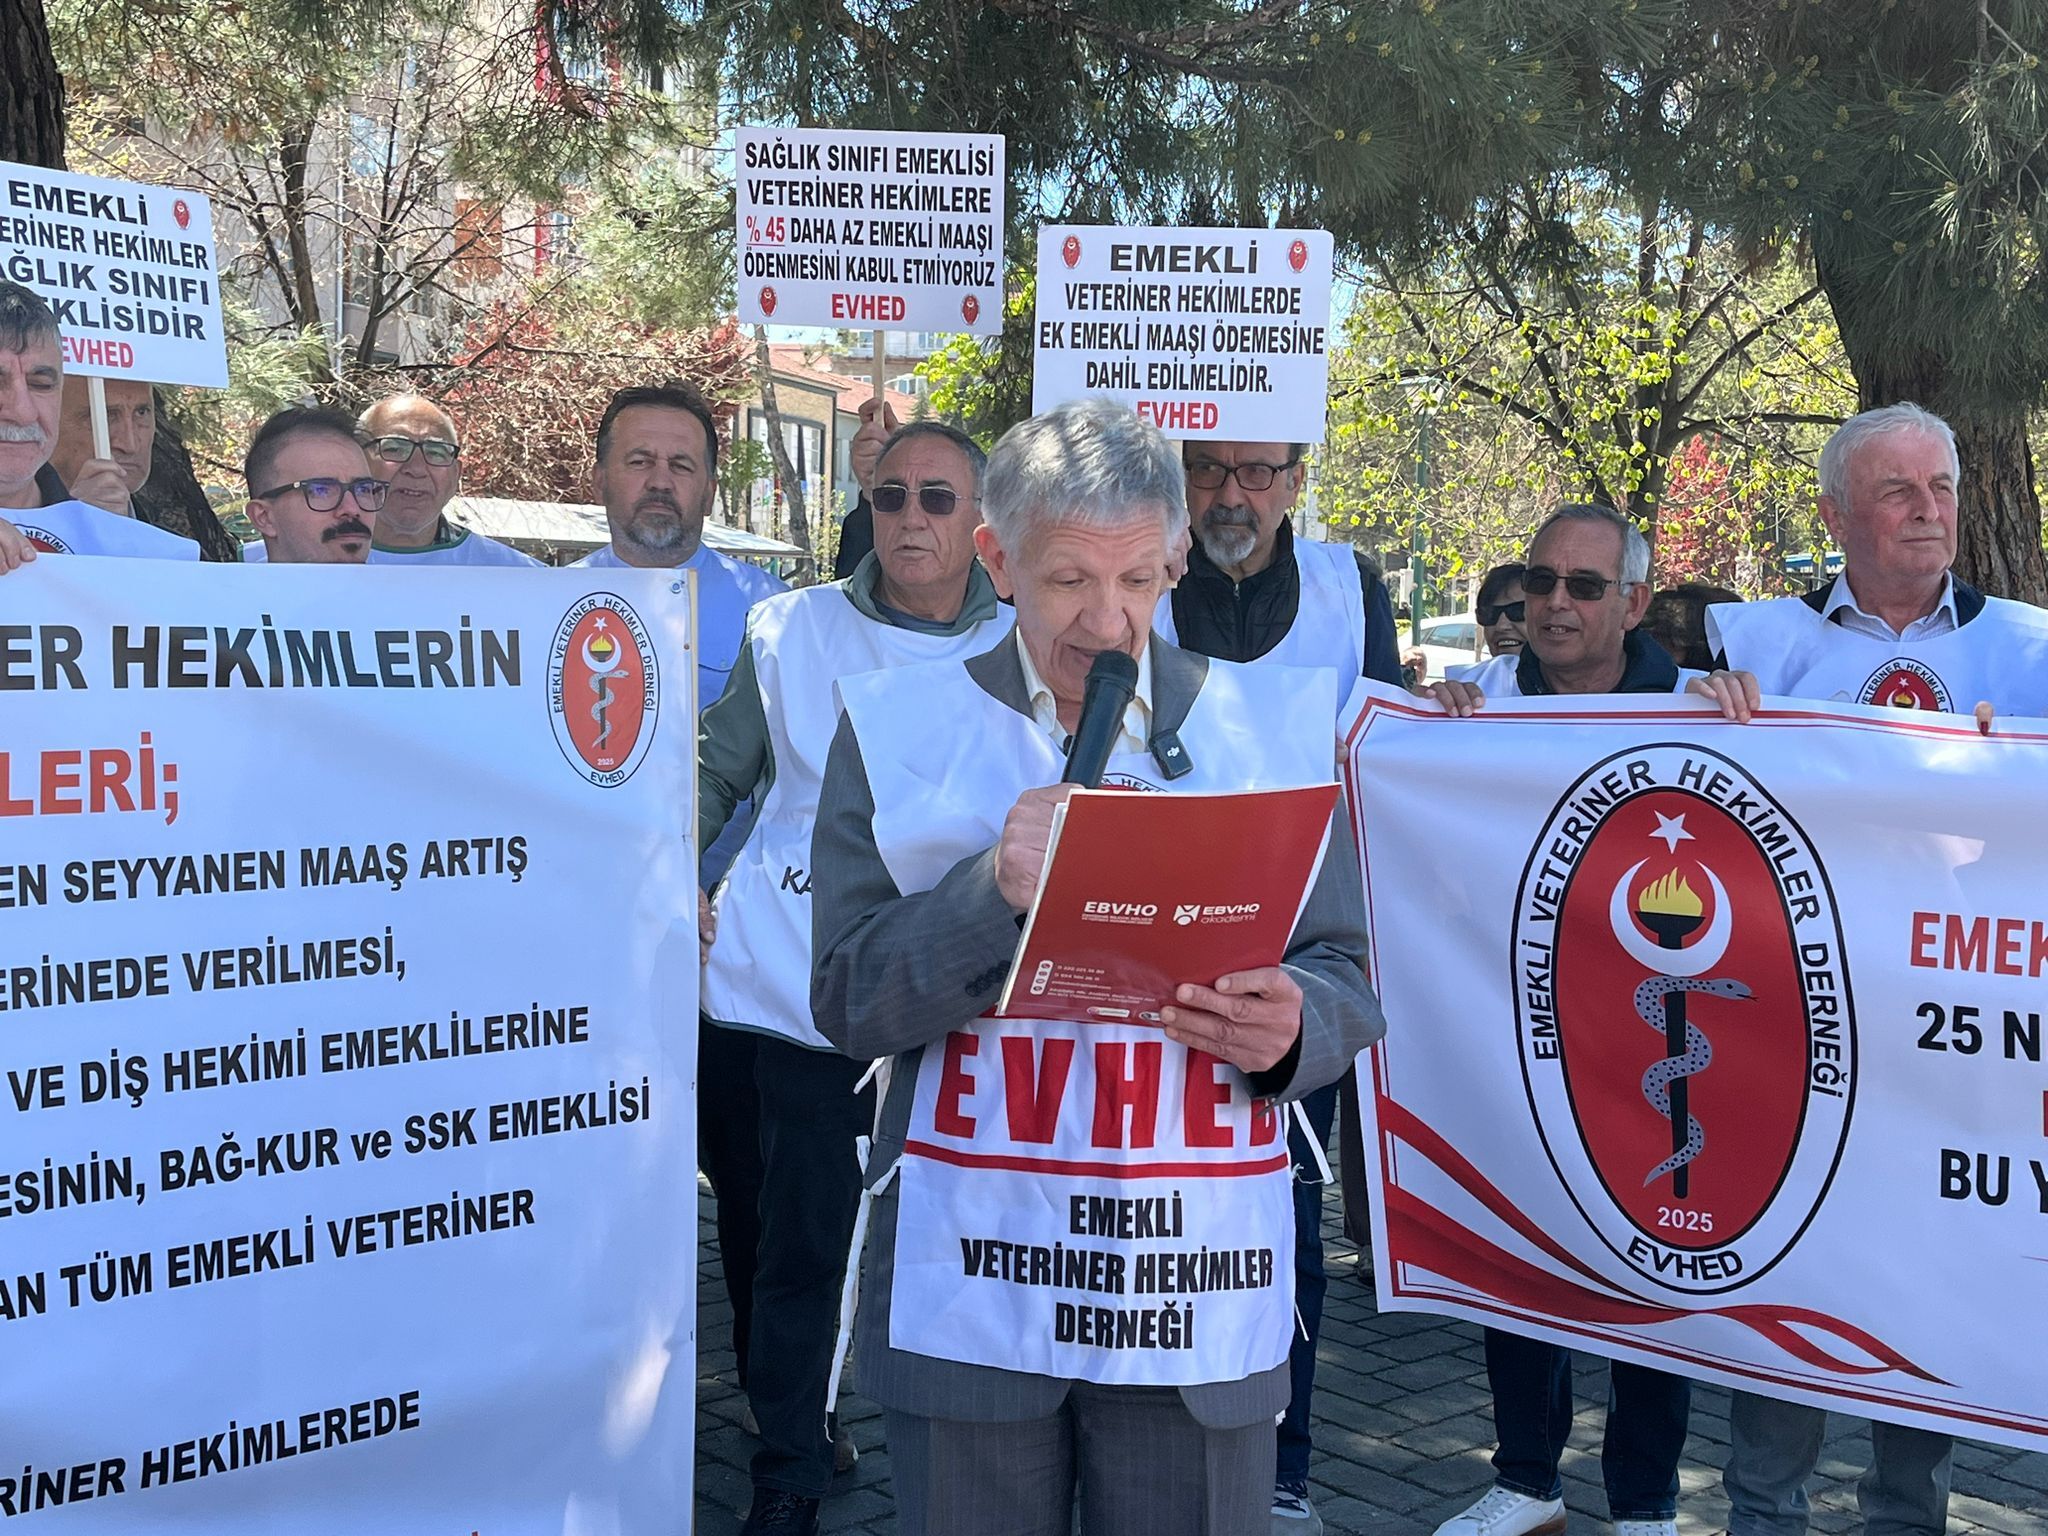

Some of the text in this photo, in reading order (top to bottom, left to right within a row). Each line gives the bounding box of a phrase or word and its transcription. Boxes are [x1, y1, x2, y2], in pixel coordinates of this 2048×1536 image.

[745, 137, 994, 176] SAĞLIK SINIFI EMEKLİSİ
[8, 180, 148, 226] EMEKLİ
[747, 175, 991, 213] VETERİNER HEKİMLERE
[94, 230, 209, 270] HEKİMLER
[746, 215, 993, 257] % 45 DAHA AZ EMEKLİ MAAŞI
[1110, 239, 1258, 274] EMEKLİ
[109, 268, 209, 305] SINIFI
[744, 247, 995, 287] ÖDENMESİNİ KABUL ETMİYORUZ
[42, 297, 206, 340] KLİSİDİR
[832, 294, 905, 321] EVHED
[1065, 277, 1301, 315] VETERİNER HEKİMLERDE
[1040, 316, 1324, 359] EK EMEKLİ MAAŞI ÖDEMESİNE
[1086, 355, 1272, 393] DAHİL EDİLMELİDİR.
[555, 598, 597, 659] VETERİNER
[604, 597, 648, 650] HEKİMLER
[0, 613, 522, 690] ER HEKİMLERİN
[552, 666, 563, 713] EMEKLİ
[1907, 662, 1946, 704] HEKİMLER
[0, 731, 179, 827] LERİ;
[590, 769, 625, 784] EVHED
[63, 850, 286, 904] SEYYANEN
[301, 842, 408, 892] MAAŞ
[420, 836, 529, 883] ARTIŞ
[1084, 901, 1158, 916] EBVHO
[1201, 912, 1257, 924] akademi
[1202, 903, 1260, 915] EBVHO
[1522, 758, 1848, 1099] EMEKLİ VETERİNER HEKİMLER DERNEĞİ
[182, 926, 407, 993] VERİLMESİ,
[1916, 1002, 1982, 1055] 25
[7, 1002, 590, 1112] VE DİŞ HEKİMİ EMEKLİLERİNE
[160, 1129, 340, 1192] BAĞ-KUR
[351, 1129, 392, 1163] ve
[404, 1108, 478, 1154] SSK
[489, 1076, 650, 1142] EMEKLİSİ
[1940, 1148, 2010, 1206] BU
[1069, 1190, 1182, 1239] EMEKLİ
[1657, 1207, 1714, 1232] 2025
[60, 1250, 152, 1307] TÜM
[168, 1215, 314, 1289] EMEKLİ
[326, 1189, 534, 1258] VETERİNER
[960, 1238, 1273, 1294] VETERİNER HEKİMLER
[1627, 1236, 1743, 1281] EVHED
[1055, 1301, 1193, 1350] DERNEĞİ
[141, 1390, 421, 1490] HEKİMLEREDE
